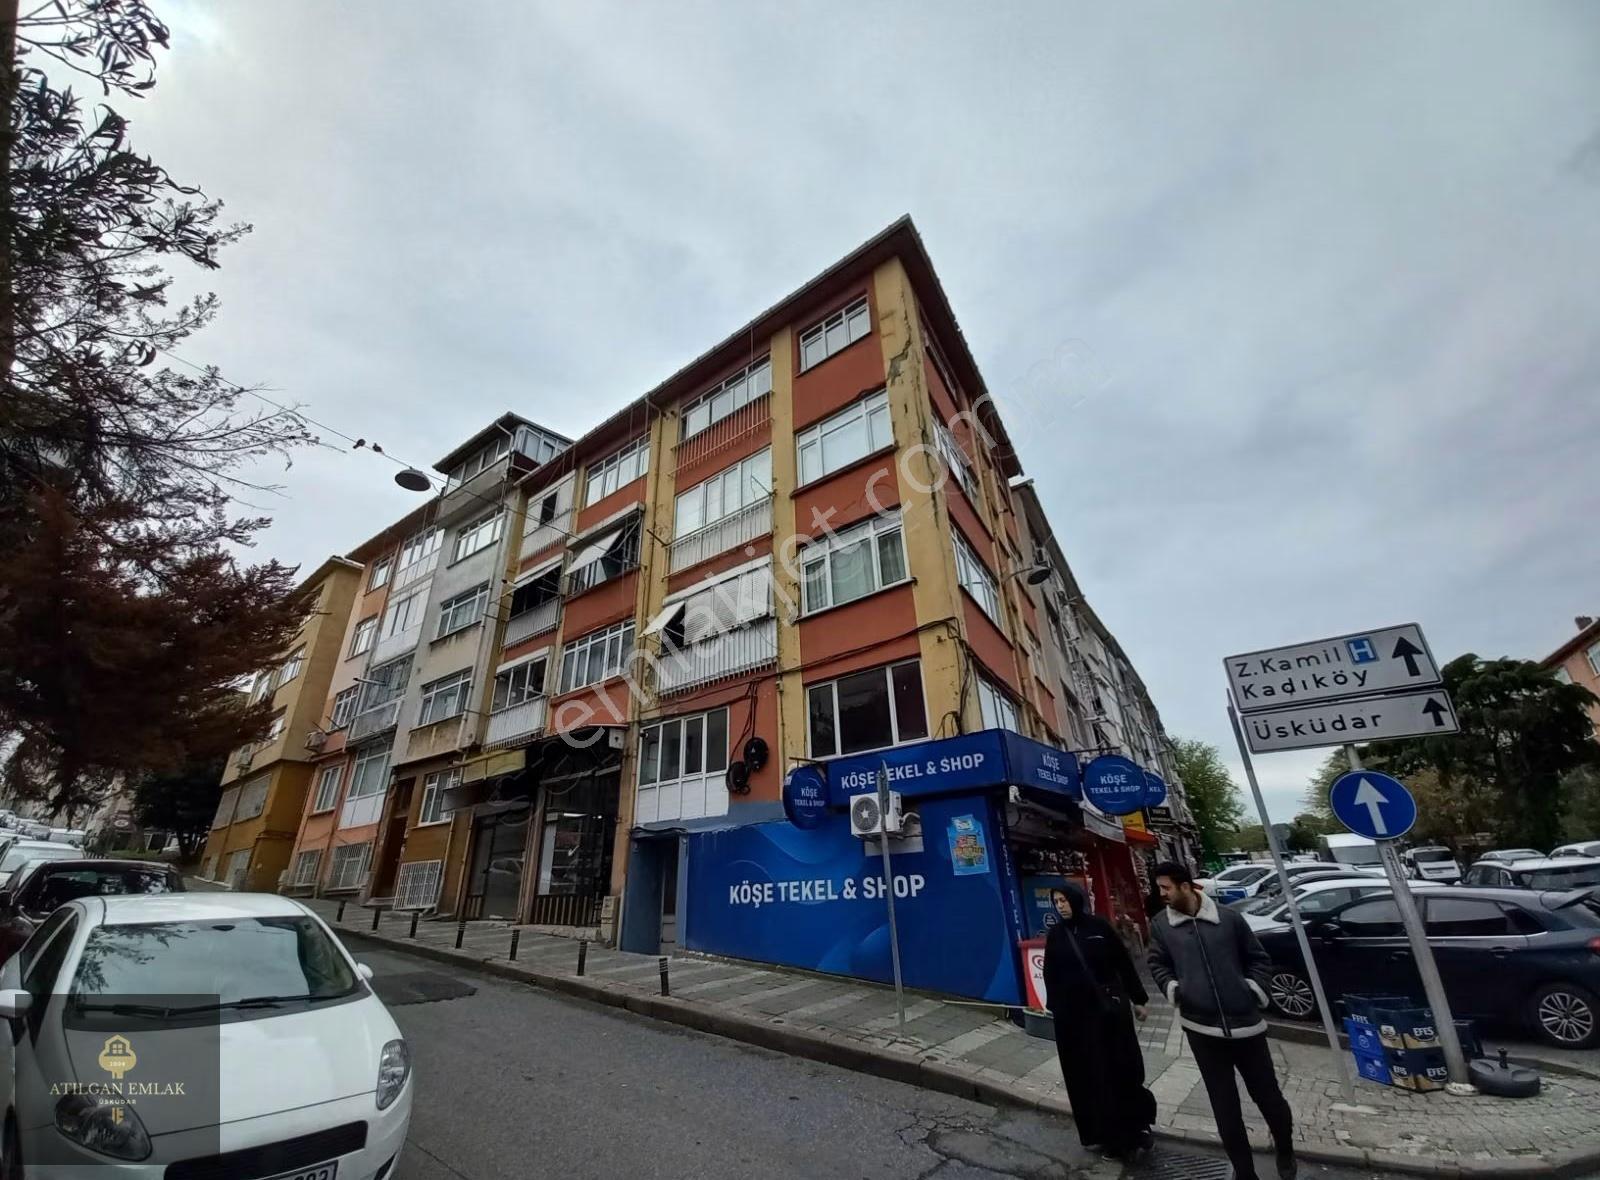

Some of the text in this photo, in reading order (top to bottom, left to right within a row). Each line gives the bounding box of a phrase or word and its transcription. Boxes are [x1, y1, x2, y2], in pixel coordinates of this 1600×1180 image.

[1235, 639, 1374, 678] Z.Kamil H
[1241, 669, 1367, 700] Kadıköy
[1253, 714, 1382, 741] Üsküdar
[1042, 753, 1060, 772] KÖŞE
[841, 753, 985, 790] KÖŞE EKEL & SHOP
[1037, 768, 1053, 782] TEKEL
[1100, 773, 1127, 786] KÖŞE
[801, 786, 818, 799] KÖŞE
[1120, 785, 1141, 793] SHOP
[729, 874, 925, 908] KÖŞE TEKEL & SHOP
[1413, 1026, 1434, 1036] EFES
[1393, 1065, 1408, 1075] EFES
[1427, 1066, 1447, 1077] EFES
